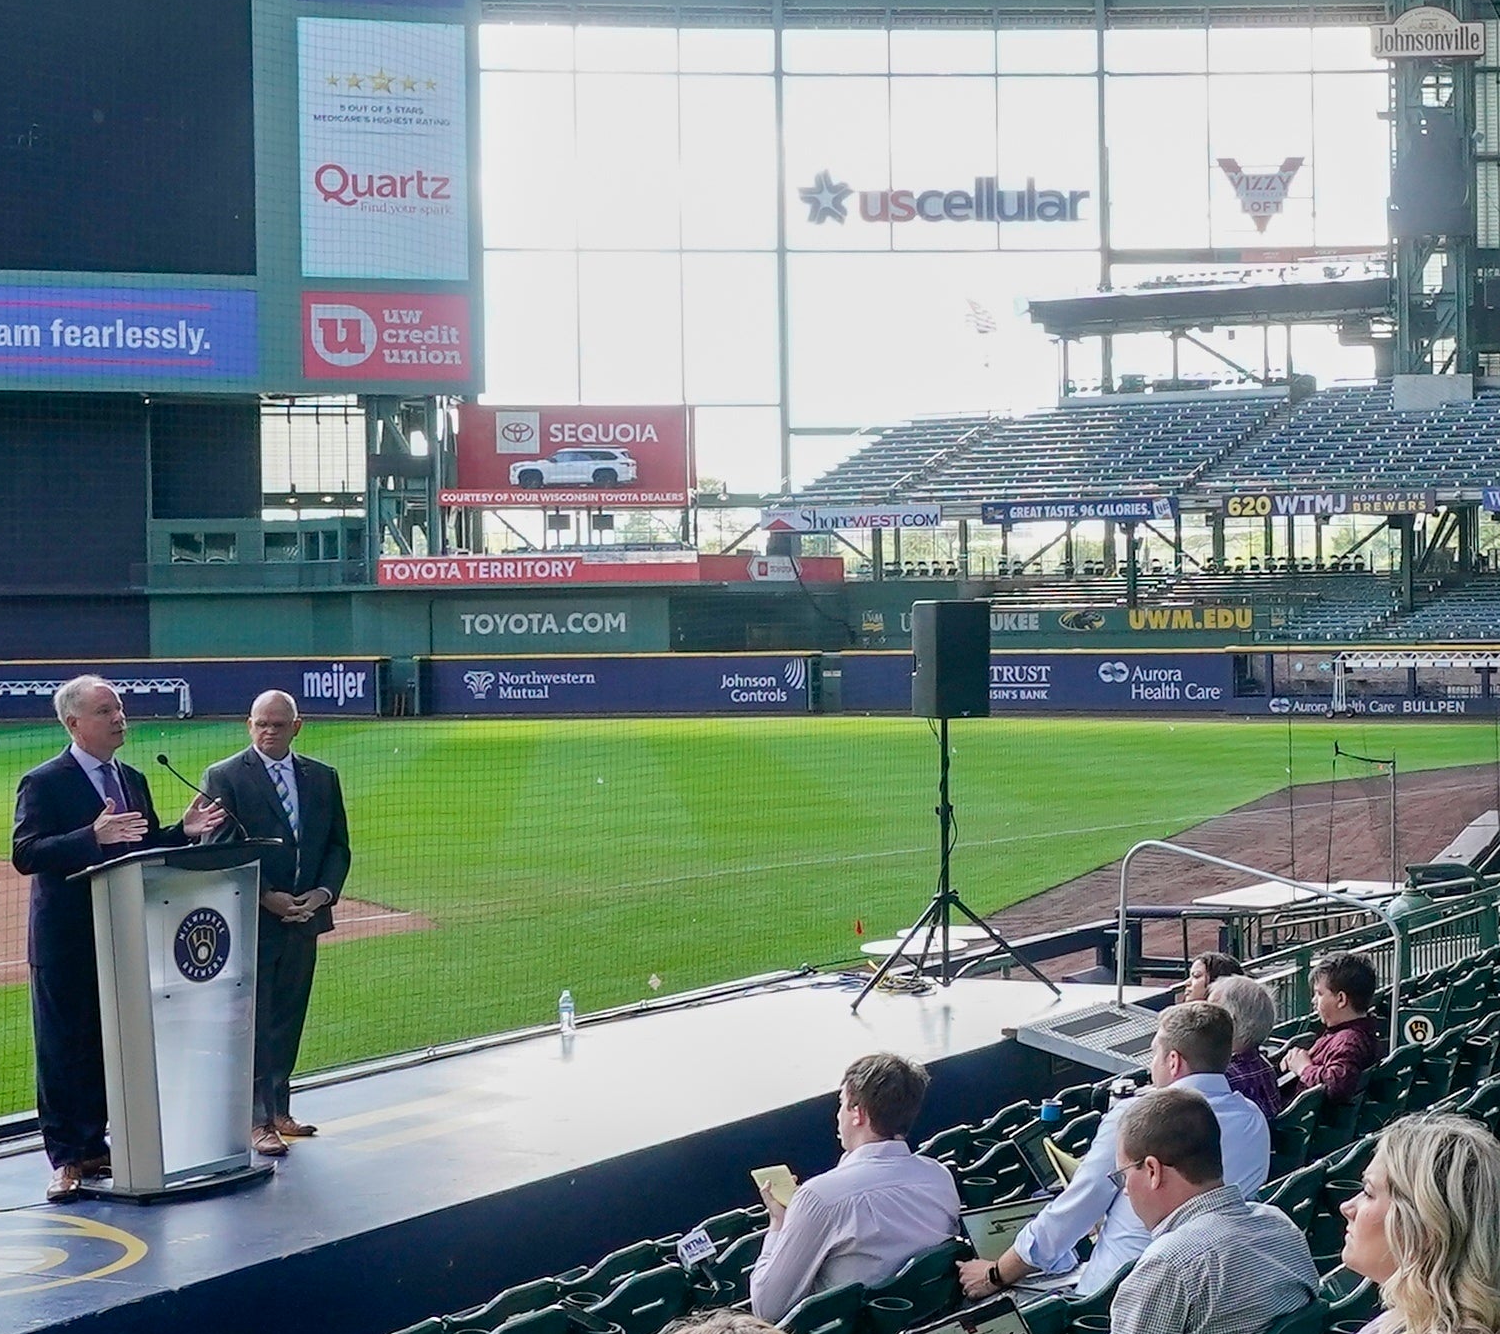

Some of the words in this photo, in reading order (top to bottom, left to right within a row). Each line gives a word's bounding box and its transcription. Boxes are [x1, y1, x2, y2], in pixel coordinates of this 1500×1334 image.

[1375, 26, 1480, 53] Johnsonville
[347, 105, 368, 113] OUT
[371, 106, 384, 114] OF
[395, 107, 424, 115] STARS
[373, 115, 413, 124] HIGHEST
[415, 117, 450, 126] RATING
[314, 163, 451, 206] Quartz
[1229, 175, 1292, 190] VIZZY
[360, 202, 386, 213] Find
[389, 204, 416, 214] your
[1243, 201, 1282, 212] LOFT
[383, 310, 422, 324] uw
[50, 317, 210, 353] fearlessly.
[383, 325, 459, 344] credit
[383, 346, 461, 364] union
[548, 423, 659, 443] SEQUOIA
[441, 493, 493, 503] COURTESY
[495, 493, 509, 503] OF
[511, 493, 539, 503] YOUR
[540, 492, 597, 502] WISCONSIN
[600, 492, 635, 502] TOYOTA
[637, 491, 685, 502] DEALERS
[1227, 496, 1272, 517] 620
[1275, 493, 1347, 515] WTMJ
[1352, 494, 1379, 503] HOME
[1384, 493, 1397, 501] OF
[1402, 492, 1425, 501] THE
[1009, 505, 1042, 518] GREAT
[1044, 504, 1079, 518] TASTE.
[1080, 503, 1096, 517] 96
[1098, 501, 1152, 516] CALORIES.
[1353, 500, 1427, 512] BREWERS
[383, 562, 461, 581] TOYOTA
[466, 560, 576, 578] TERRITORY
[461, 613, 626, 636] TOYOTA.COM
[1128, 608, 1253, 631] UWM.EDU
[499, 671, 595, 687] Northwestern
[1131, 666, 1182, 682] Aurora
[302, 663, 366, 702] meijer
[721, 675, 776, 690] Johnson
[1131, 680, 1181, 700] Health
[1185, 684, 1221, 701] Care
[499, 685, 548, 700] Mutual
[730, 688, 788, 704] Controls
[1020, 690, 1048, 699] BANK
[1293, 700, 1328, 712] Aurora
[1369, 700, 1394, 712] Care
[1402, 700, 1465, 714] BULLPEN
[182, 955, 224, 977] BREWERS
[683, 1234, 708, 1251] WTMJ
